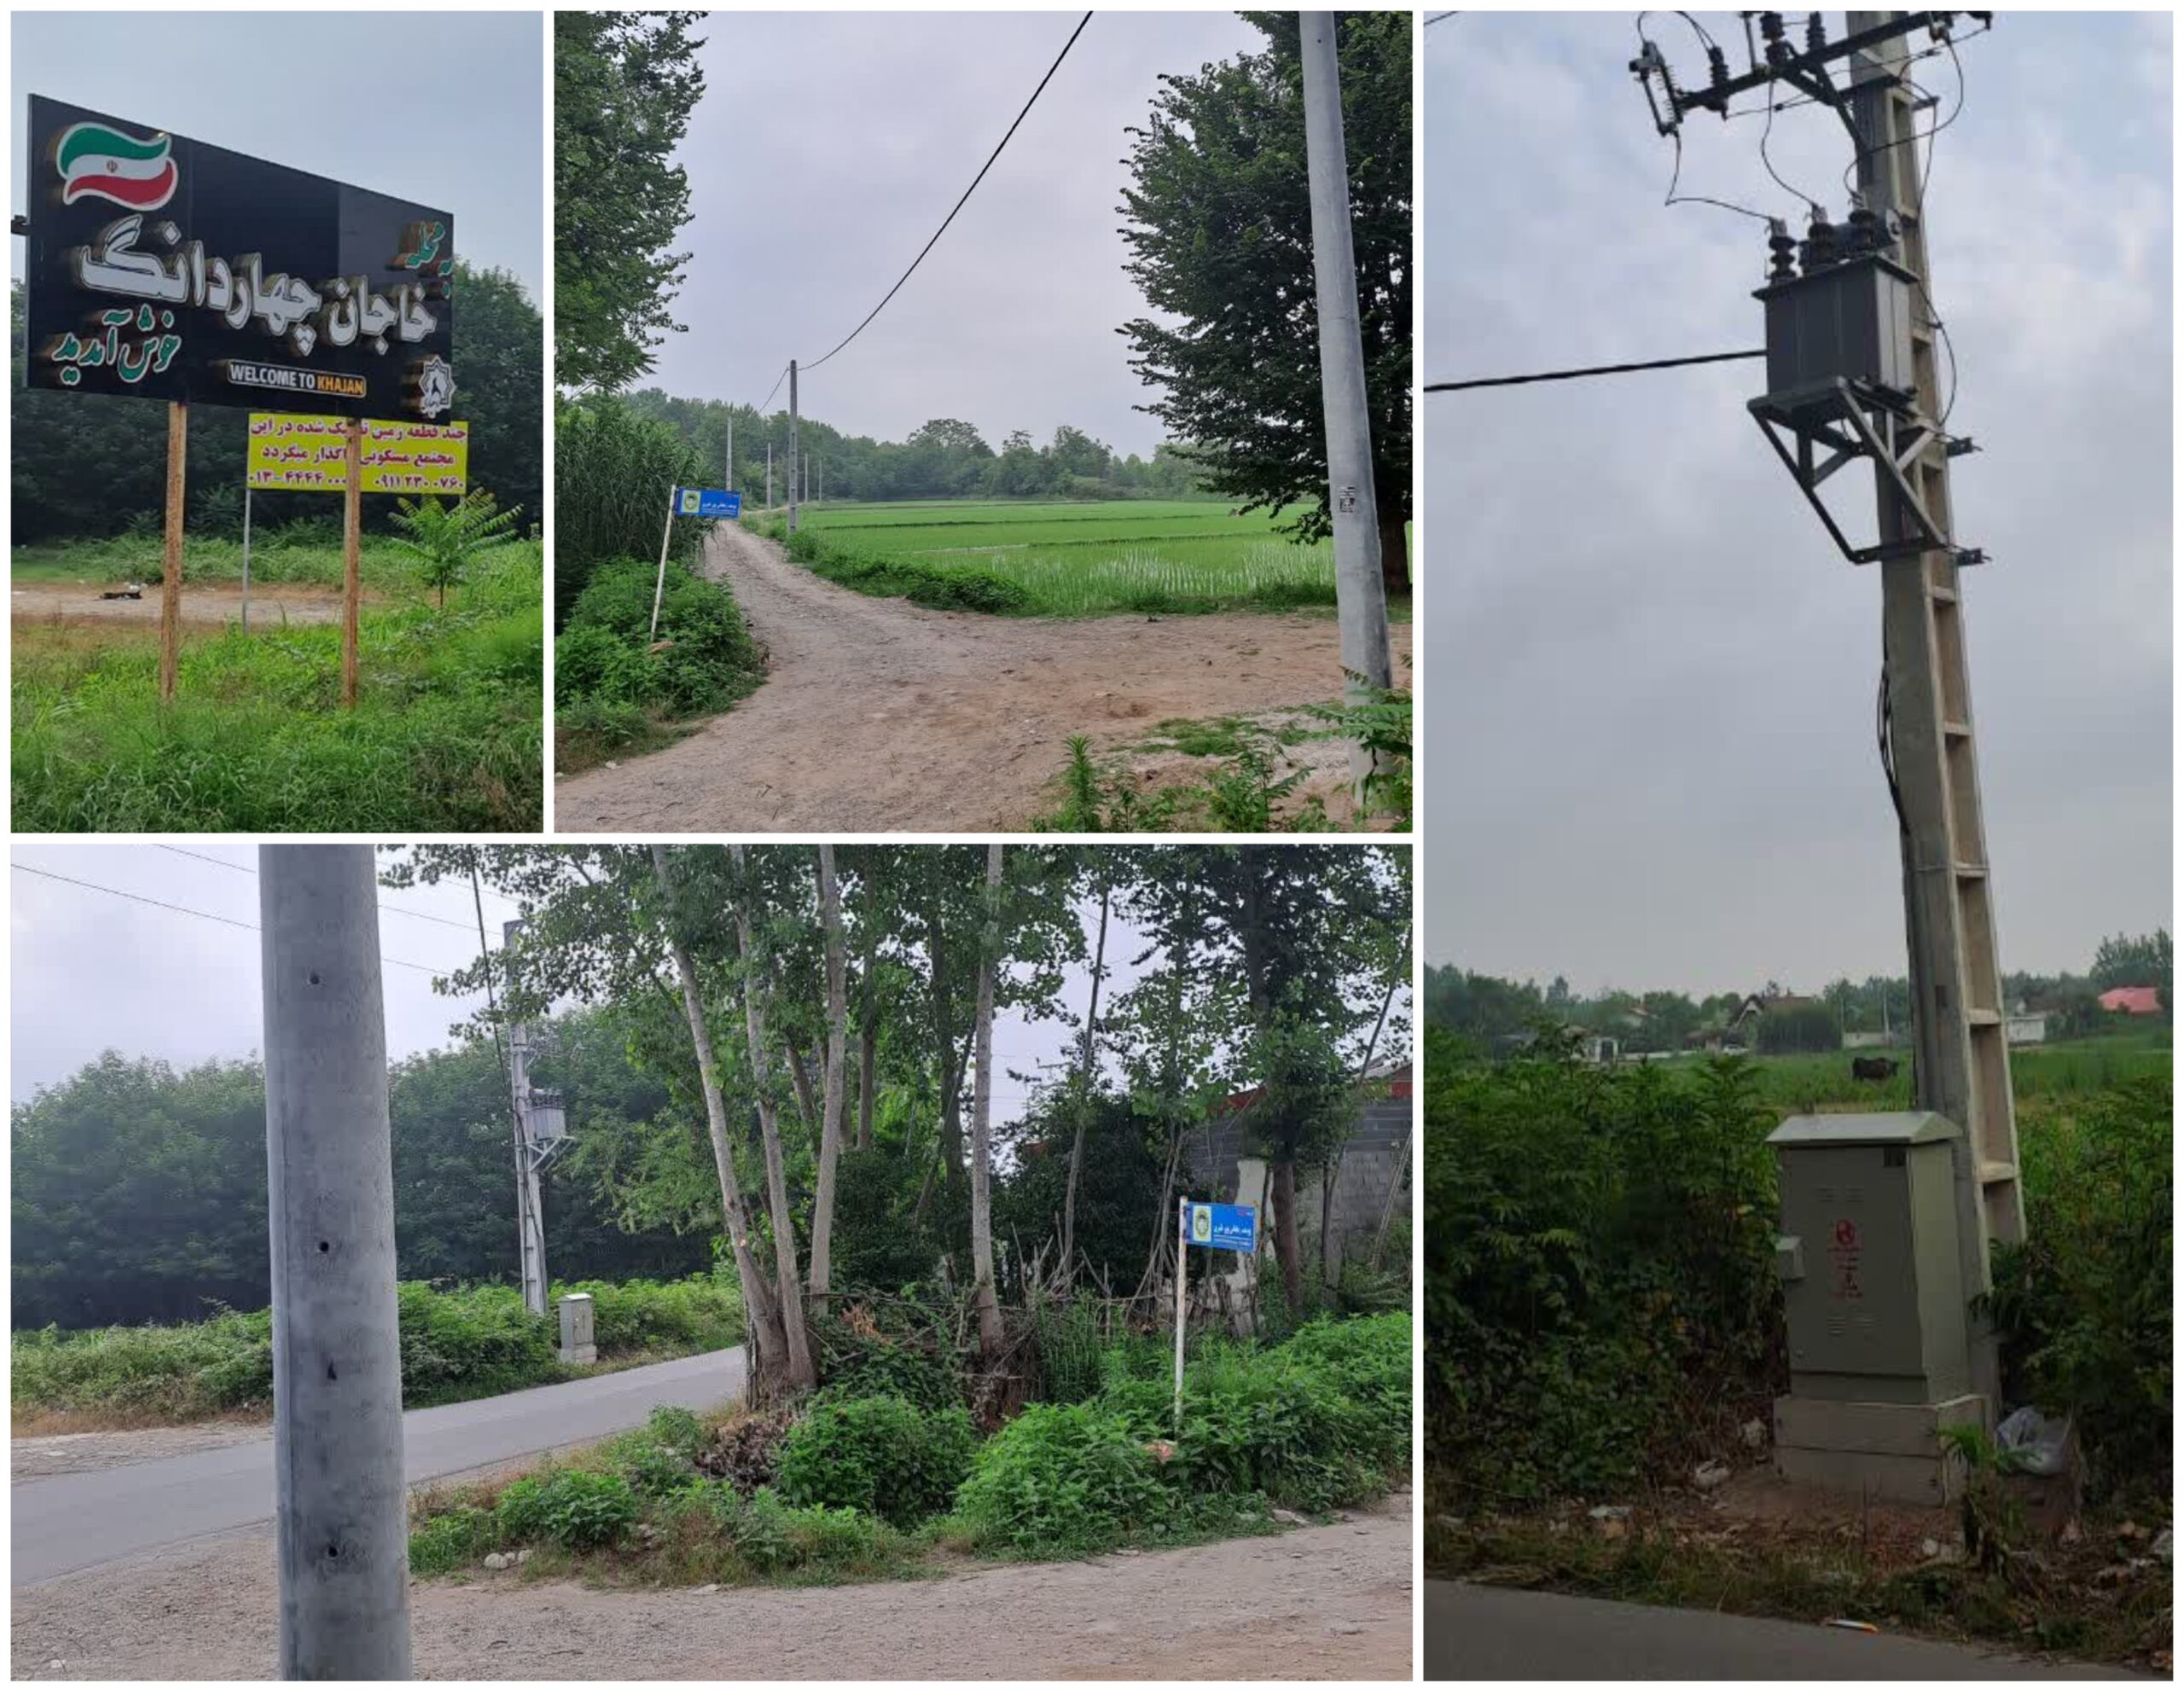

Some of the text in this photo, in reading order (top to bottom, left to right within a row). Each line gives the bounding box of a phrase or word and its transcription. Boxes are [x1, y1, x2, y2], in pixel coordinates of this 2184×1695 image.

[329, 275, 437, 356] خاجان
[51, 303, 182, 386] خوش آمدید
[230, 363, 364, 395] WELCOME TO KHAJAN
[251, 418, 272, 435] این
[277, 422, 293, 436] در
[297, 421, 324, 433] شده
[372, 427, 403, 440] زمین
[407, 426, 439, 438] قطعه
[442, 427, 467, 442] چند
[263, 445, 454, 467] مجتمع مسکونی اگذار میگردد
